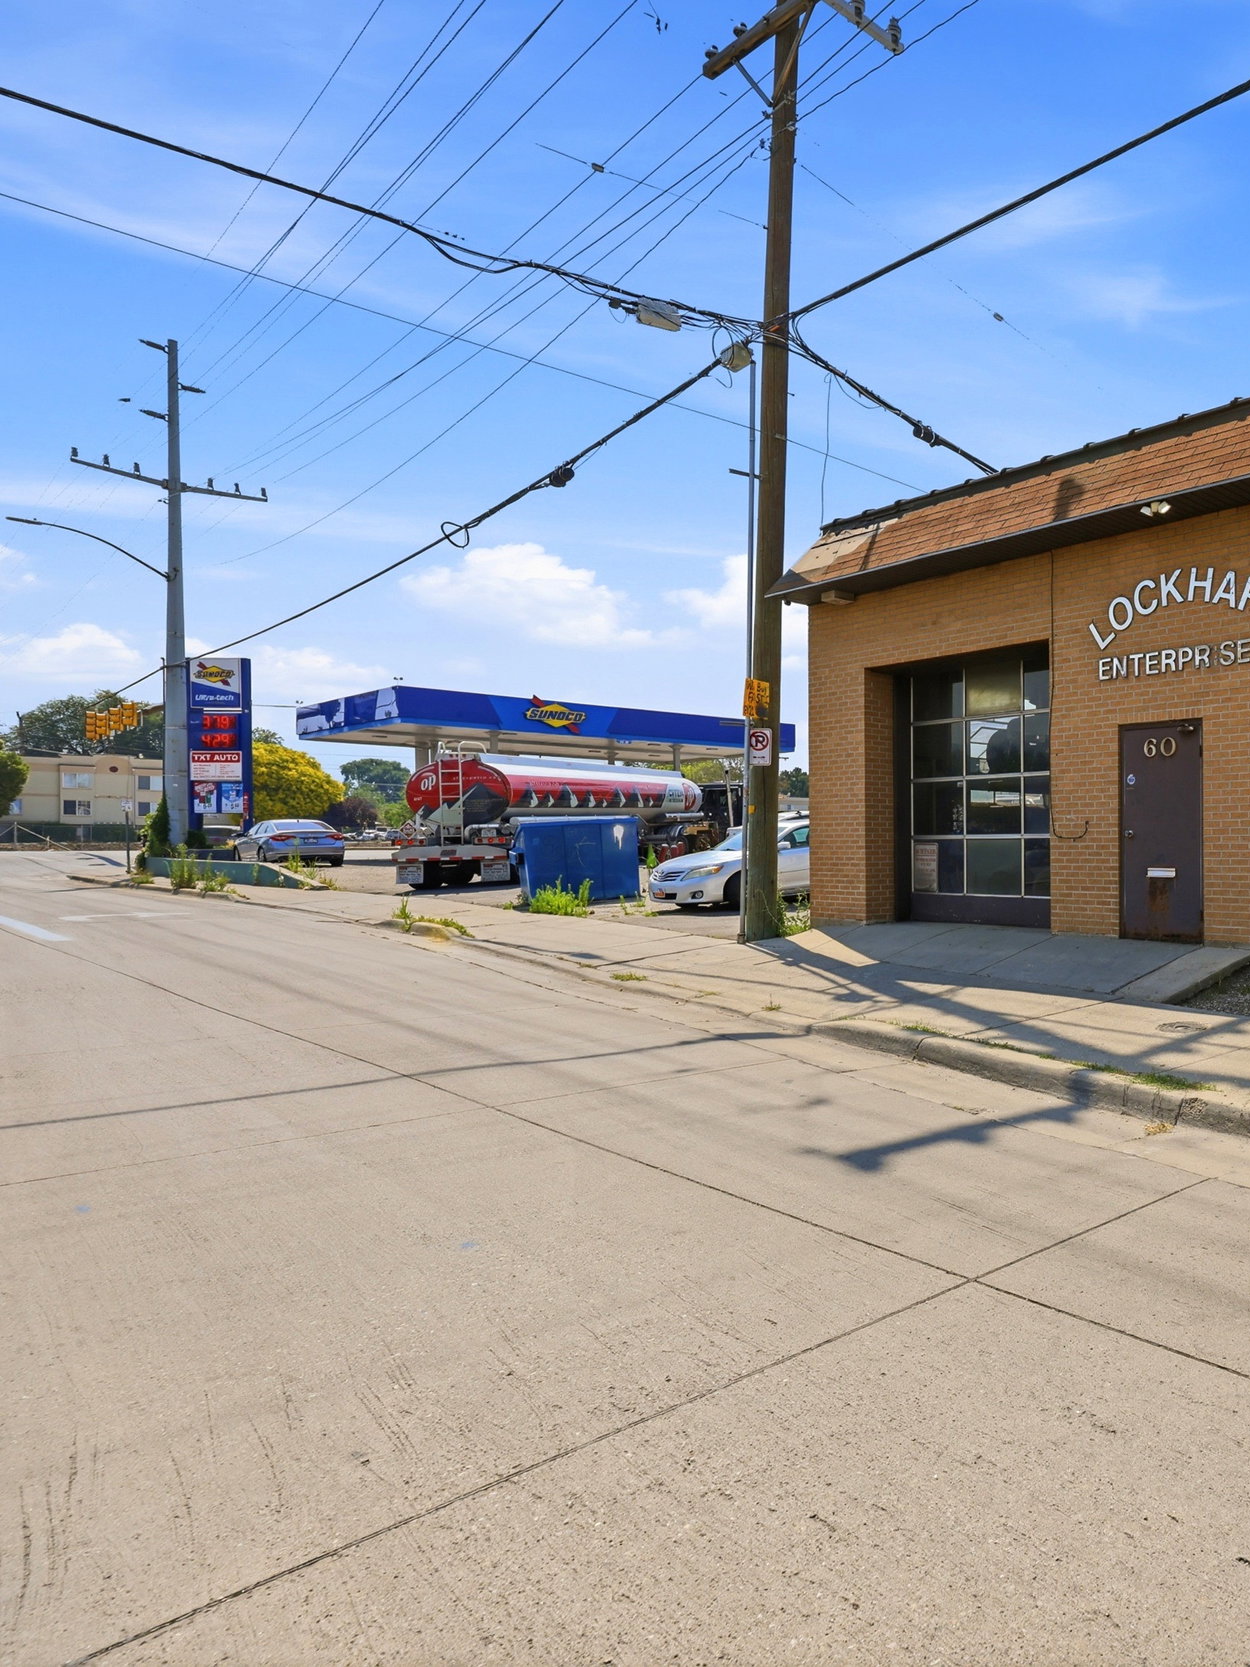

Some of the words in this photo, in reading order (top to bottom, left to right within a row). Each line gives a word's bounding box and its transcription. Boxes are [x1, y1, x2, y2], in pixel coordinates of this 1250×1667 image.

[195, 669, 235, 680] SUNOCO
[526, 707, 586, 724] SUNOCO
[1143, 736, 1177, 758] 60
